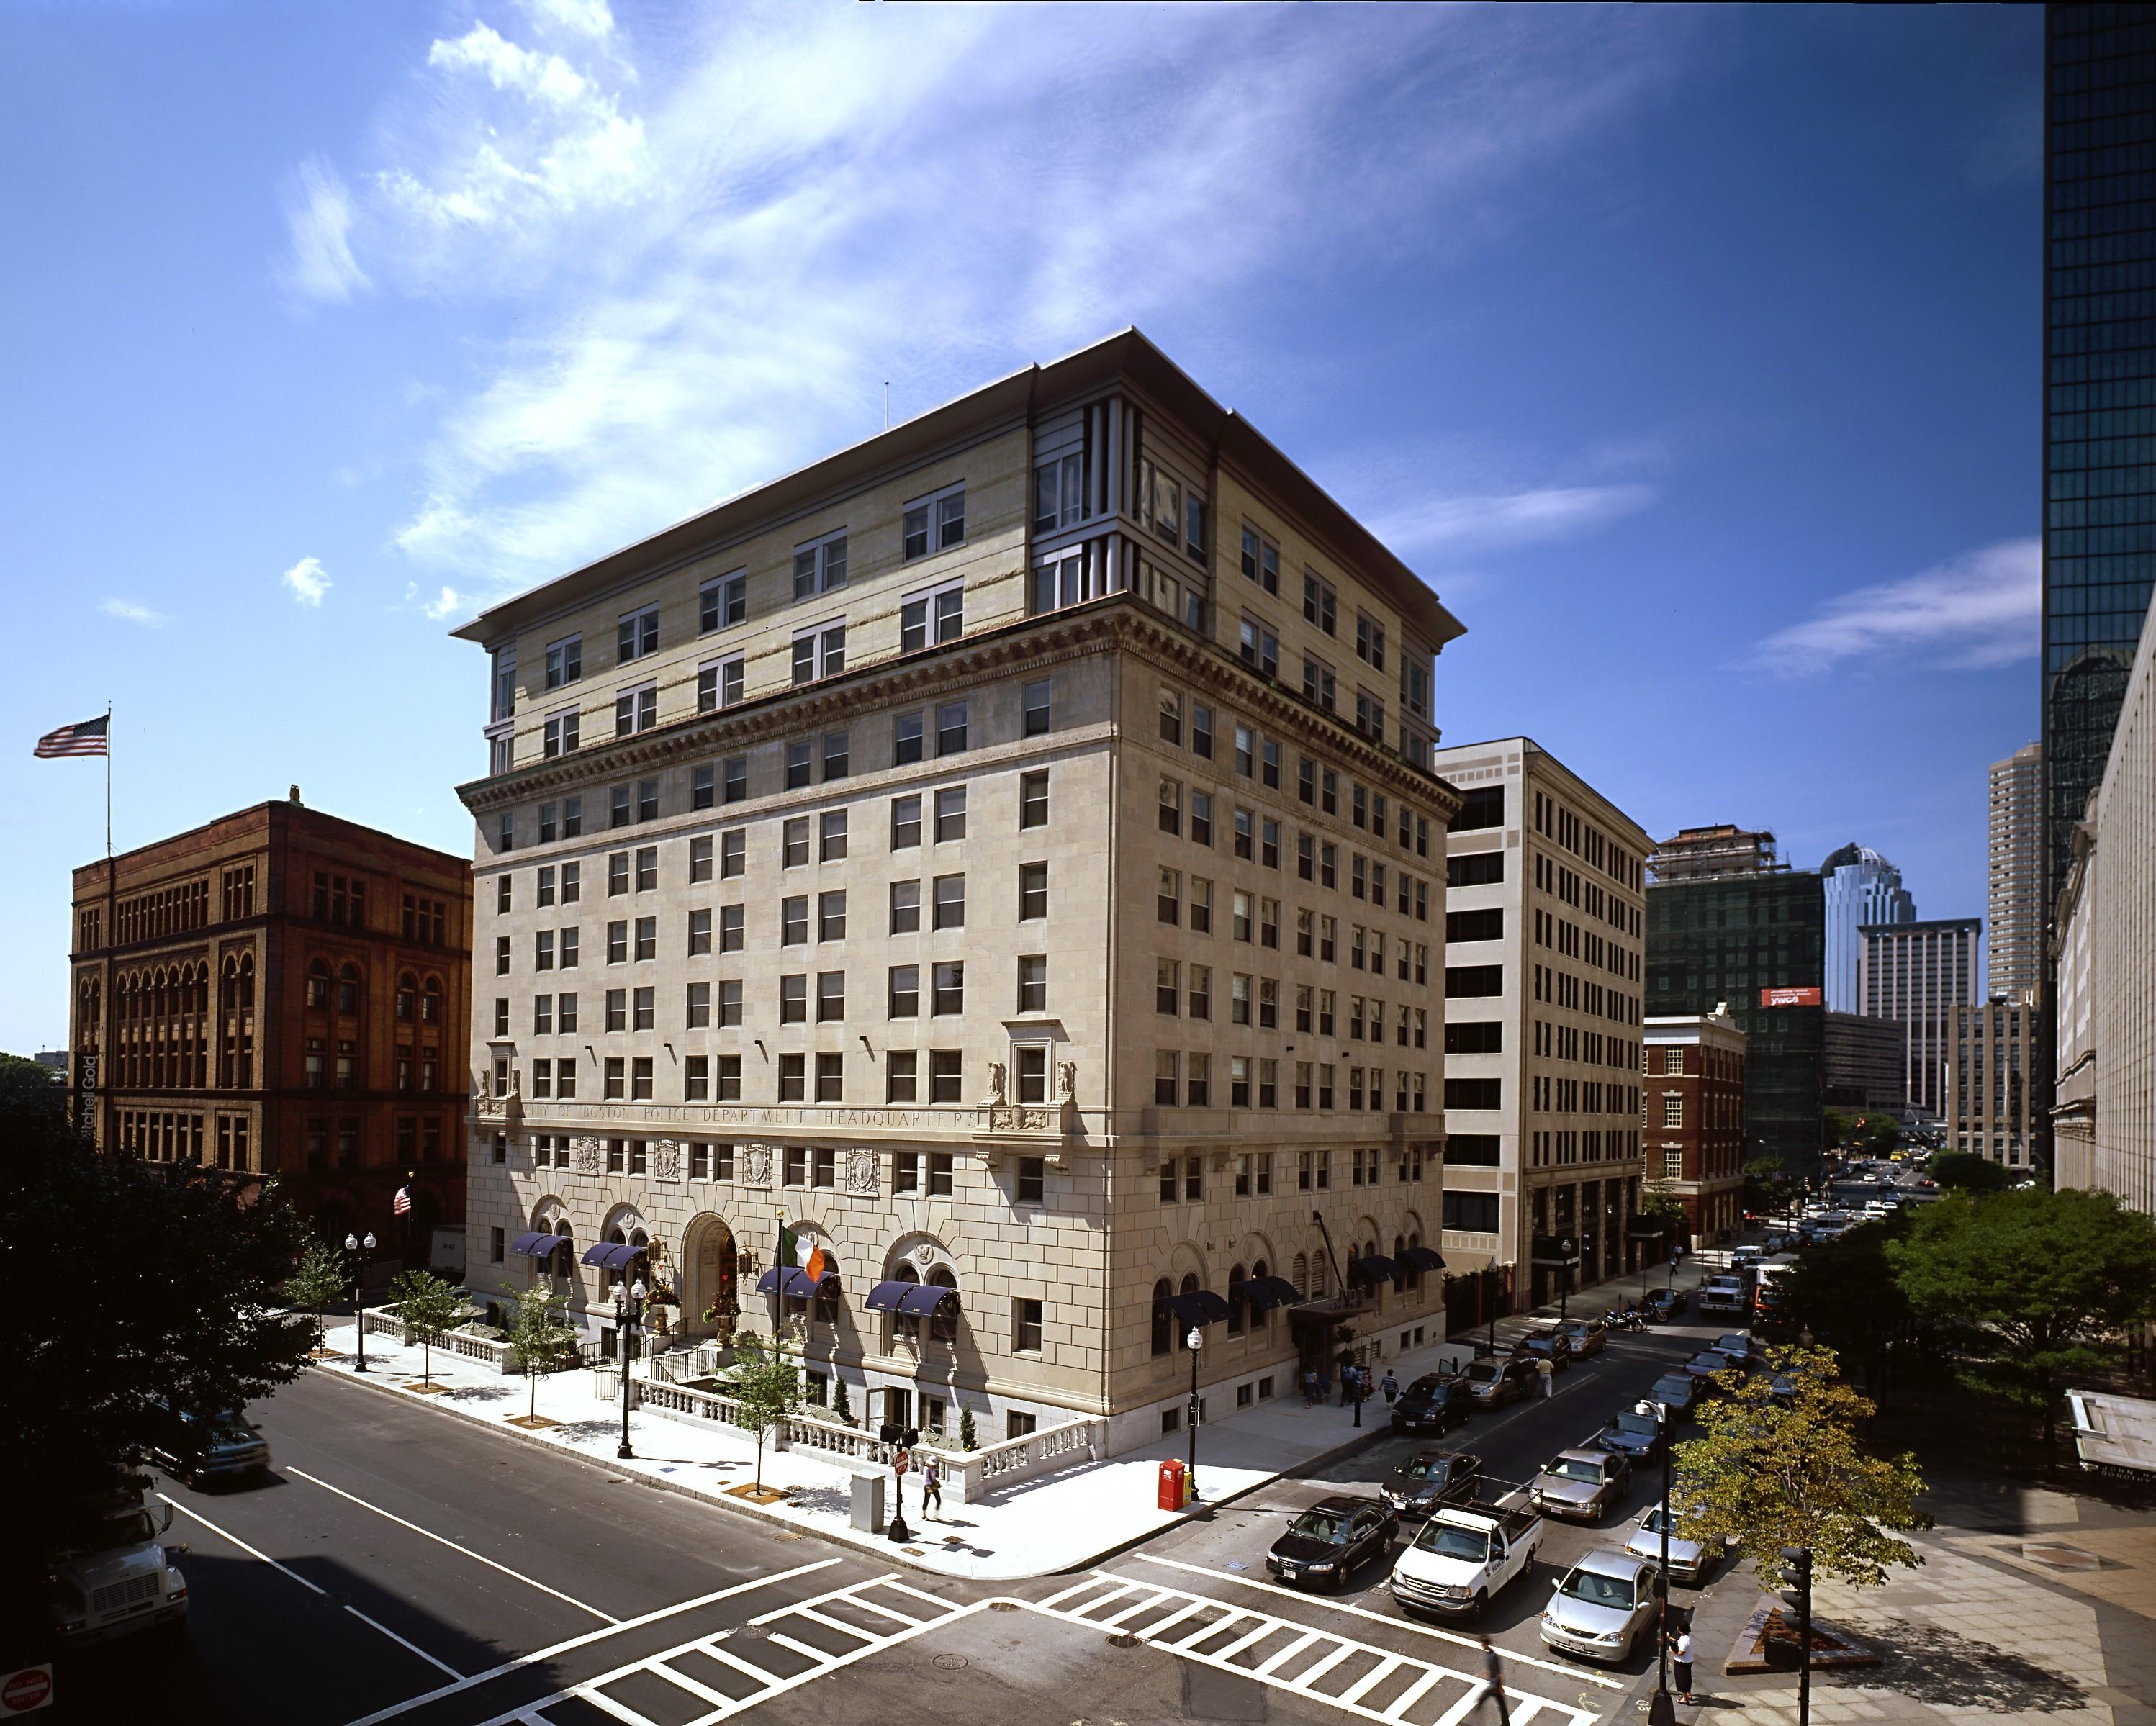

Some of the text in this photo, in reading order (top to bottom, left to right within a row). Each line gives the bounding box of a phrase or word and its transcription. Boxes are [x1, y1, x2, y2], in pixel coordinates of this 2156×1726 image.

[1771, 996, 1798, 1006] ywca
[82, 1055, 96, 1090] Gold
[524, 1104, 976, 1129] CITY OF BOSTON POLICE DEPARTMENT HEADQUARTERS
[2101, 1470, 2151, 1483] DOROTHY
[2102, 1465, 2134, 1475] JOHN
[8, 1675, 45, 1690] DO NOT
[12, 1691, 41, 1704] ENTER
